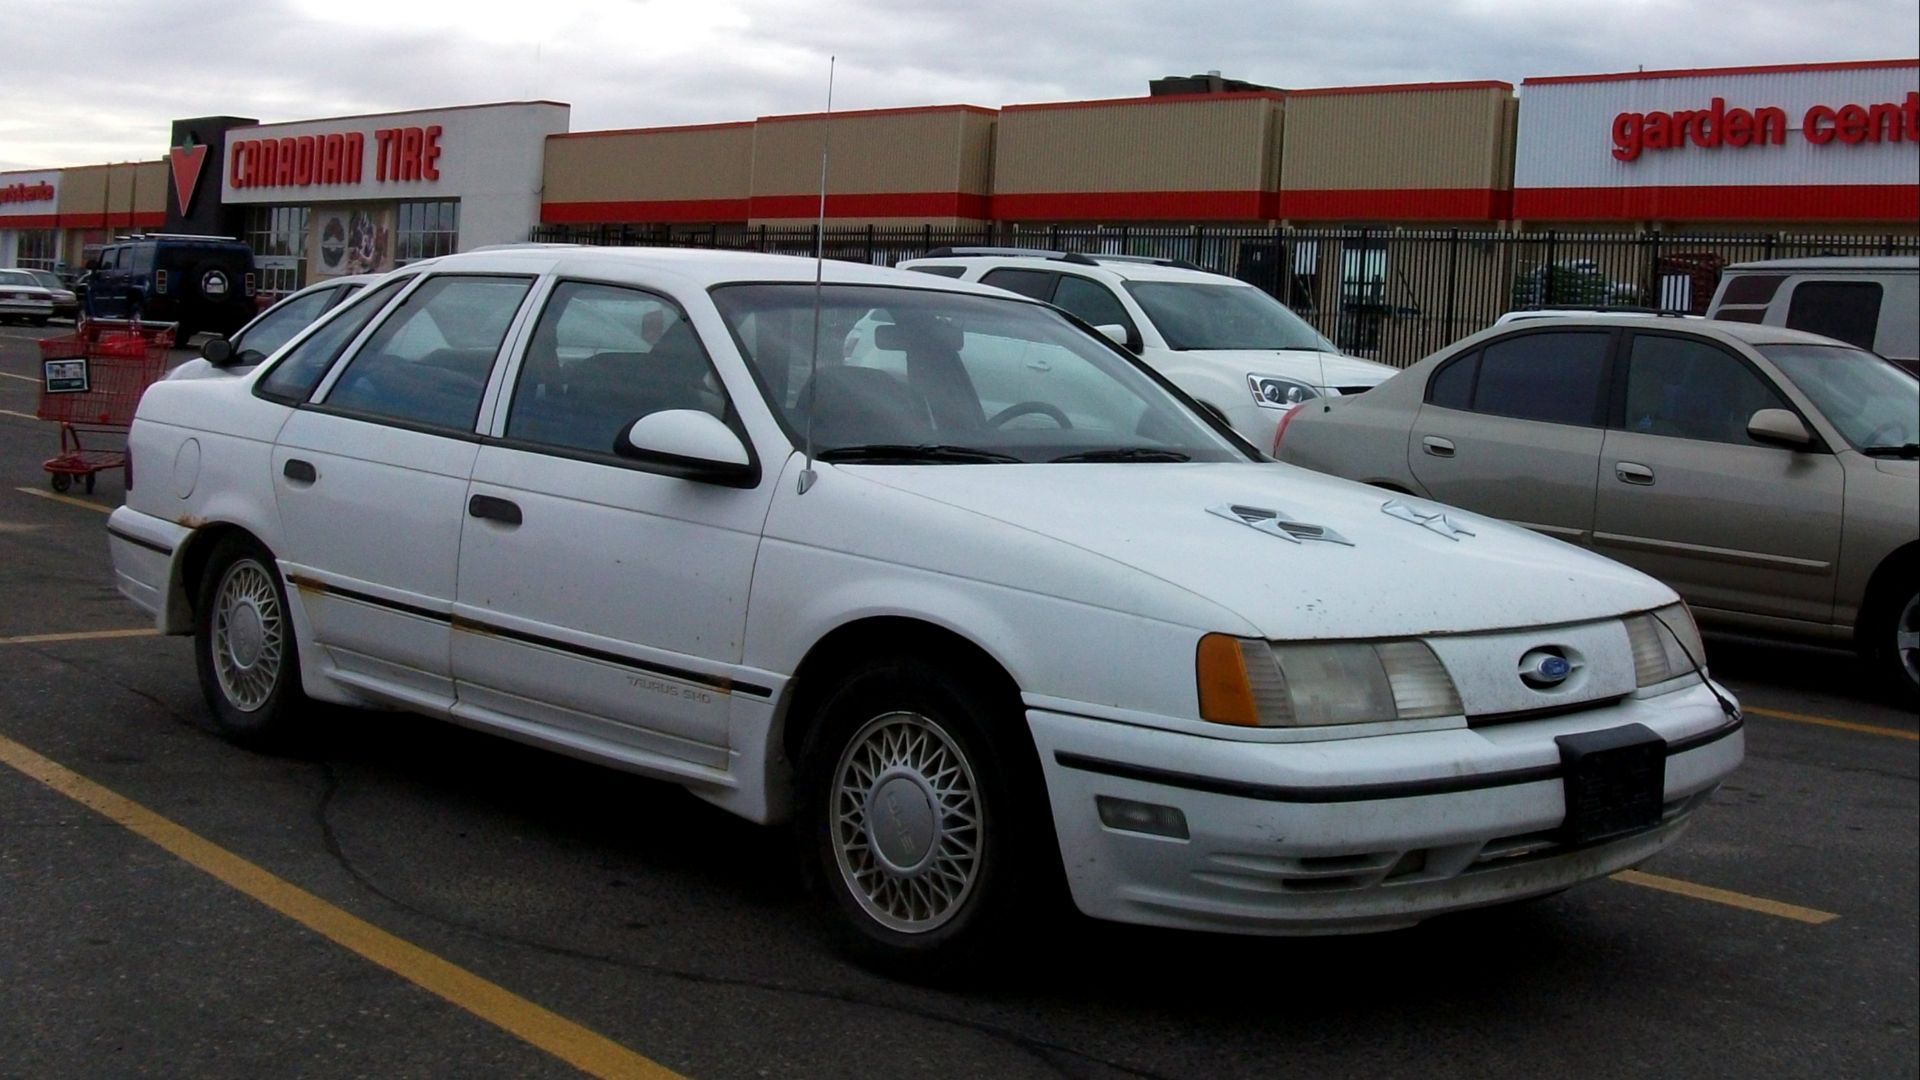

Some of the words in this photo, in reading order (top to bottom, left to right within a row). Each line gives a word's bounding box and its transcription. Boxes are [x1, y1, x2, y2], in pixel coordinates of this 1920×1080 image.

[230, 132, 364, 188] CANADIAN
[374, 125, 442, 181] TIRE
[1611, 97, 1787, 162] garden
[1803, 91, 1919, 145] cent
